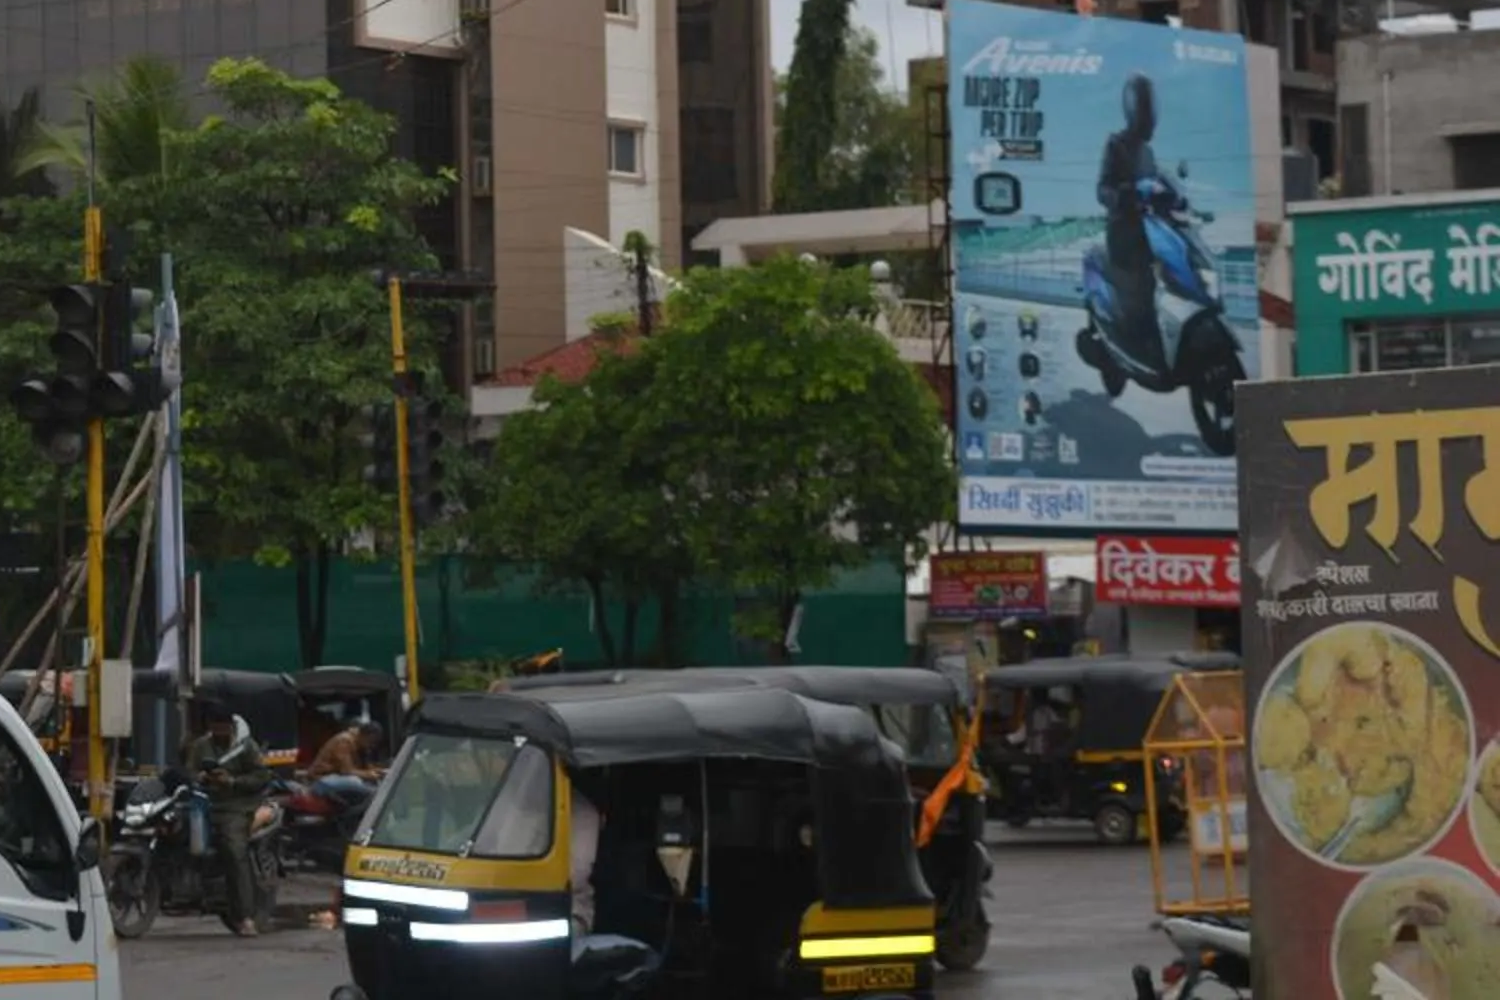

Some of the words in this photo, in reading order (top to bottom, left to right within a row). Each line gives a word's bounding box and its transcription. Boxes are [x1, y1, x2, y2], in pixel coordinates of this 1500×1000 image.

[961, 36, 1103, 76] Avenis
[964, 75, 1010, 109] MORE
[1316, 229, 1434, 304] गोविंद
[1102, 540, 1214, 588] दिवेकर
